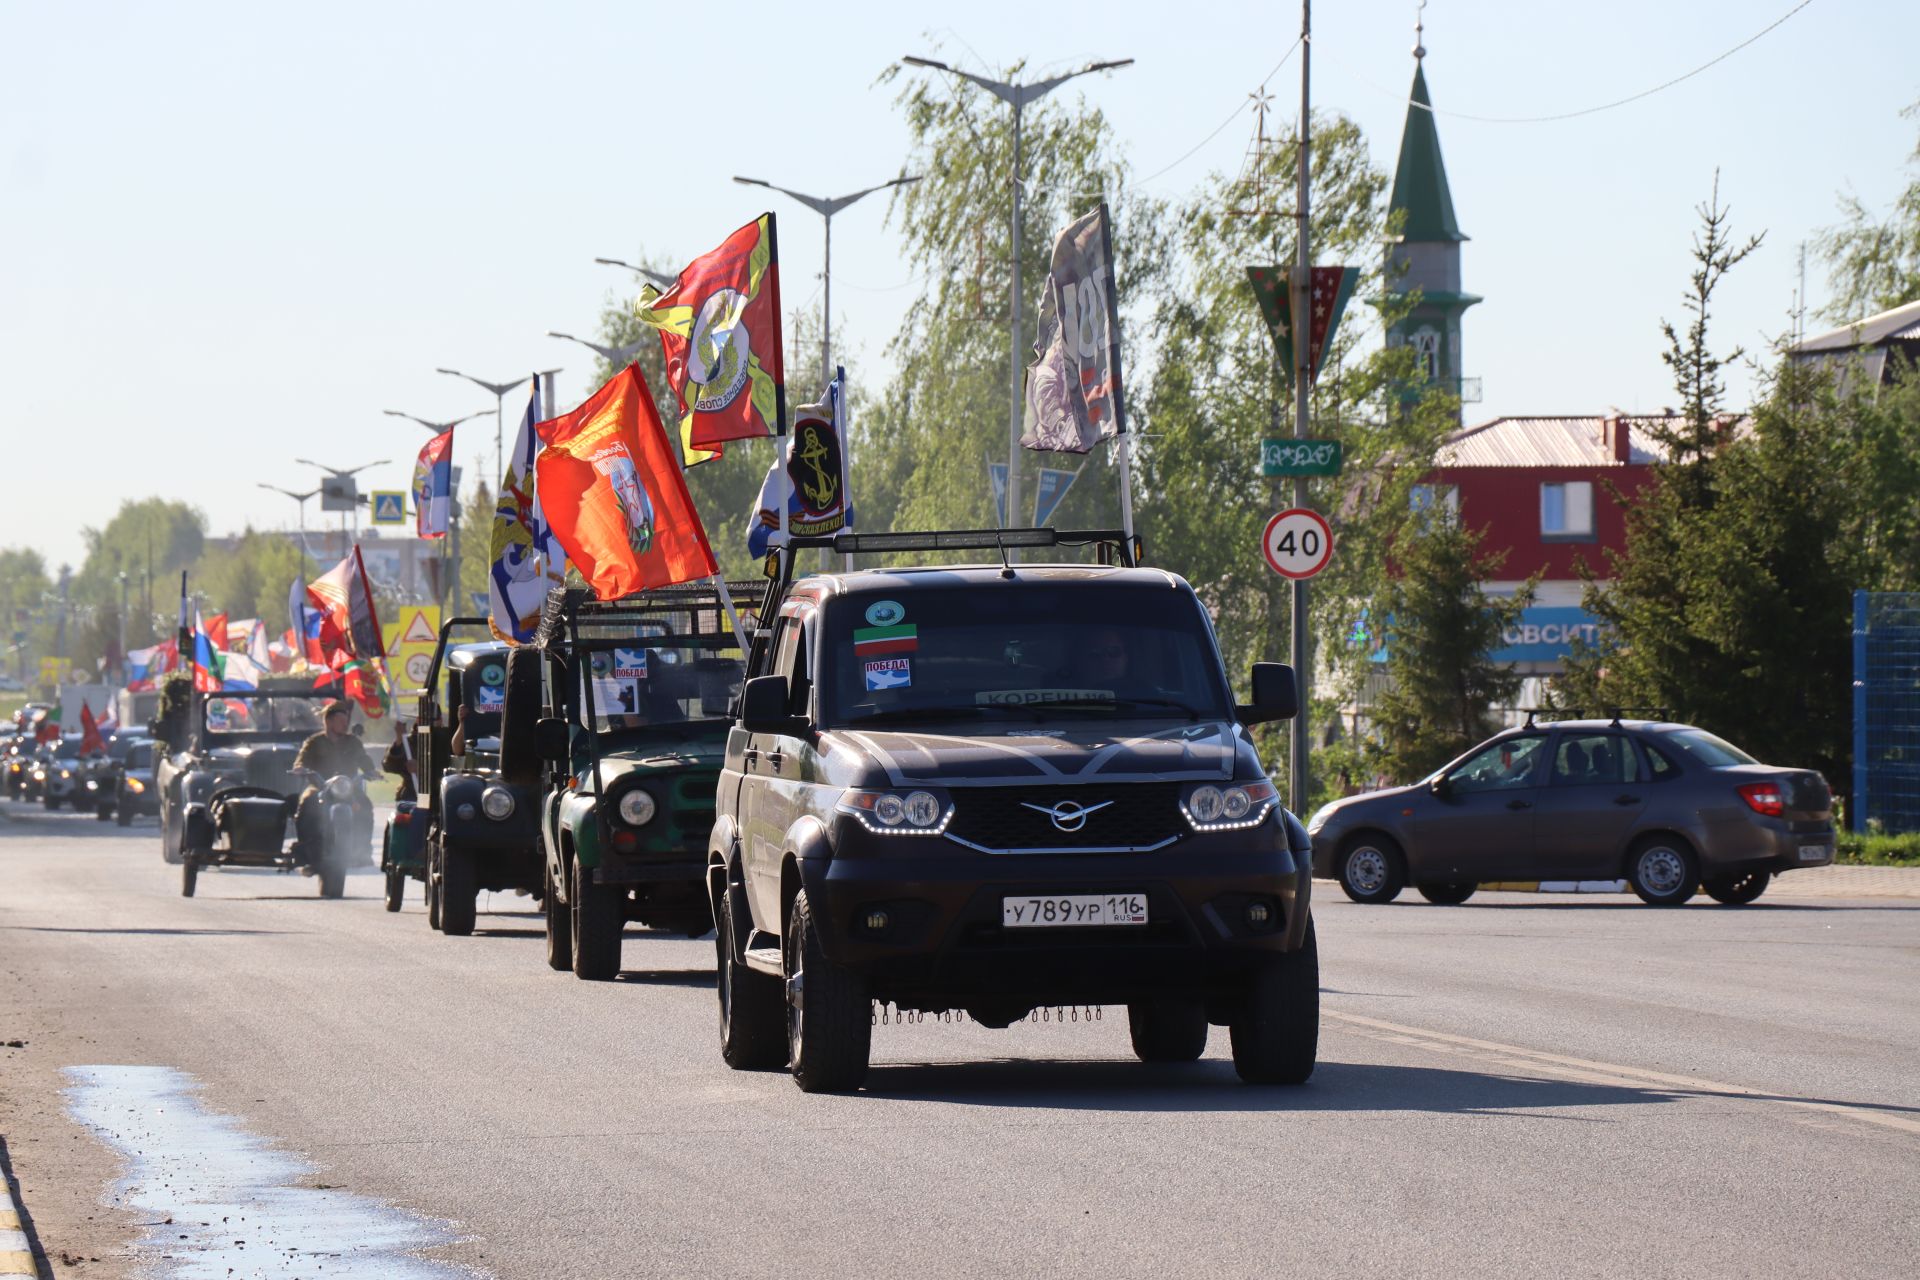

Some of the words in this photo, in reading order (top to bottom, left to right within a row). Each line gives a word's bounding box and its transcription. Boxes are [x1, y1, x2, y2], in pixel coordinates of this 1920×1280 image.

[820, 514, 844, 533] ПЕХОТ
[1276, 529, 1320, 557] 40
[866, 660, 909, 672] ПОБЕДА!
[1106, 897, 1140, 914] 116
[1113, 914, 1132, 922] RUS
